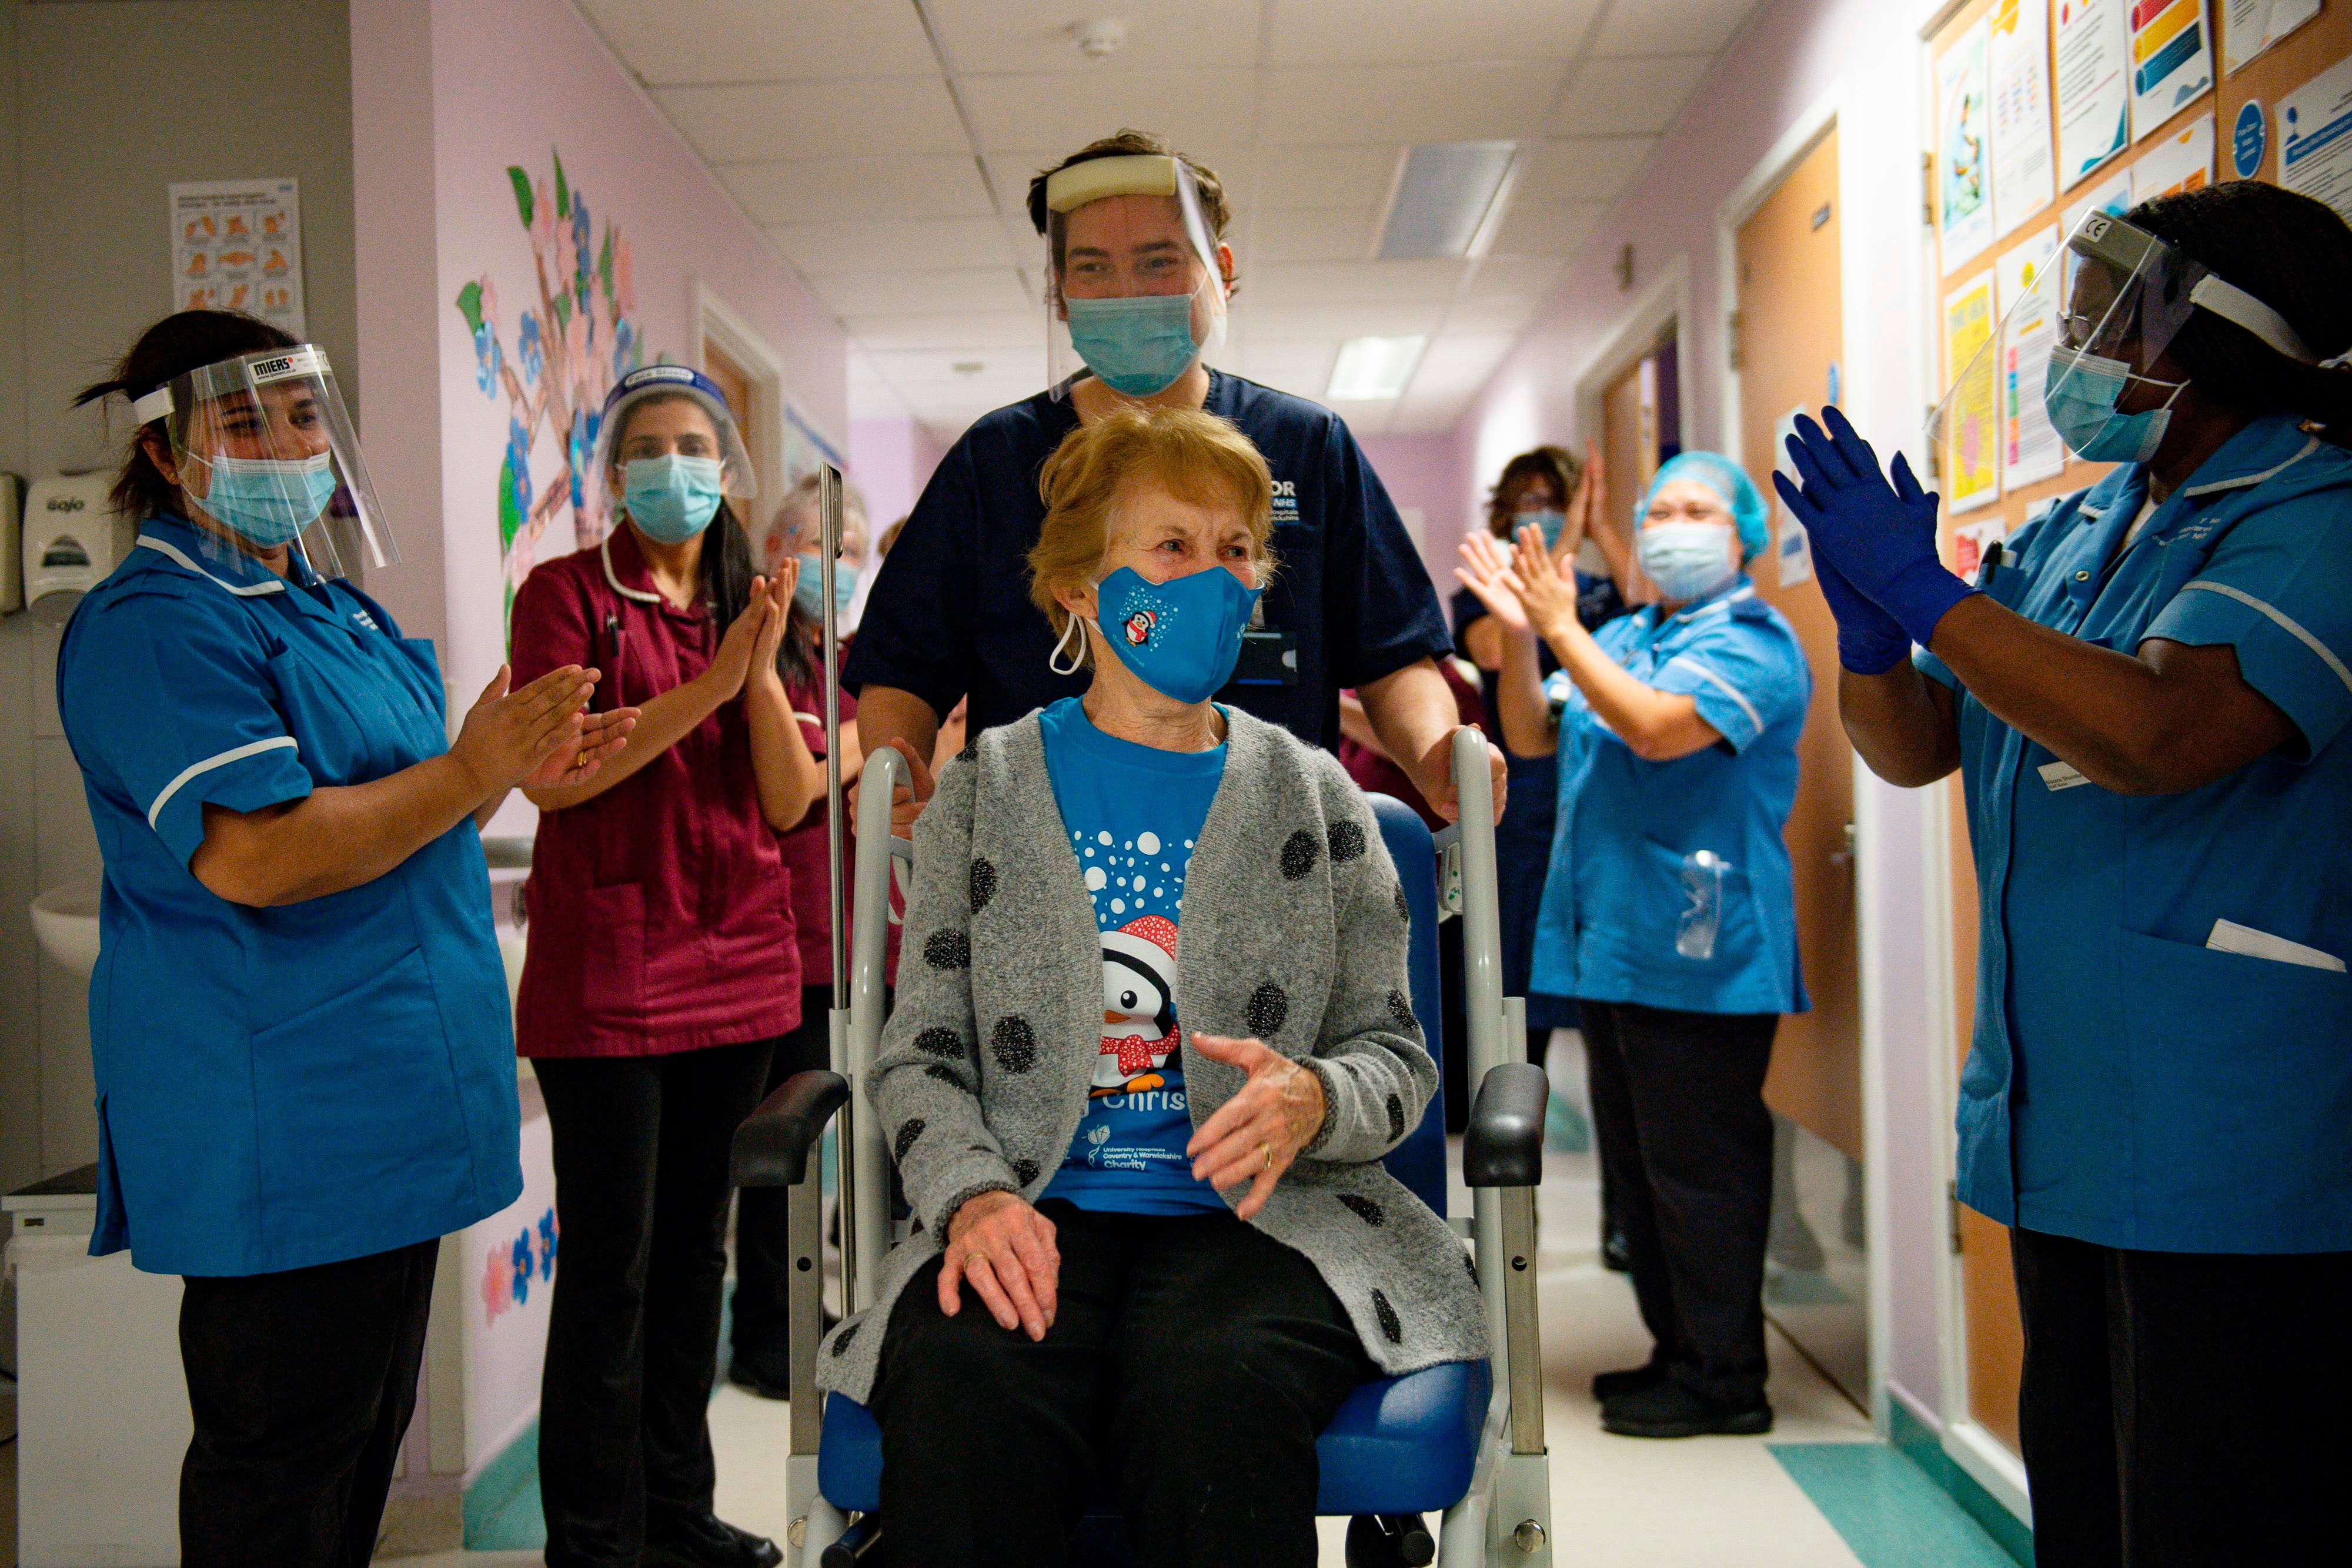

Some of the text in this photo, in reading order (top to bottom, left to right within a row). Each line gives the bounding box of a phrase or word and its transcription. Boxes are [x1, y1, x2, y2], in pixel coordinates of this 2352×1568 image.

[254, 357, 290, 376] MIERS
[1271, 480, 1296, 496] OR
[1102, 1091, 1185, 1112] Chris
[1104, 1159, 1146, 1171] Charity
